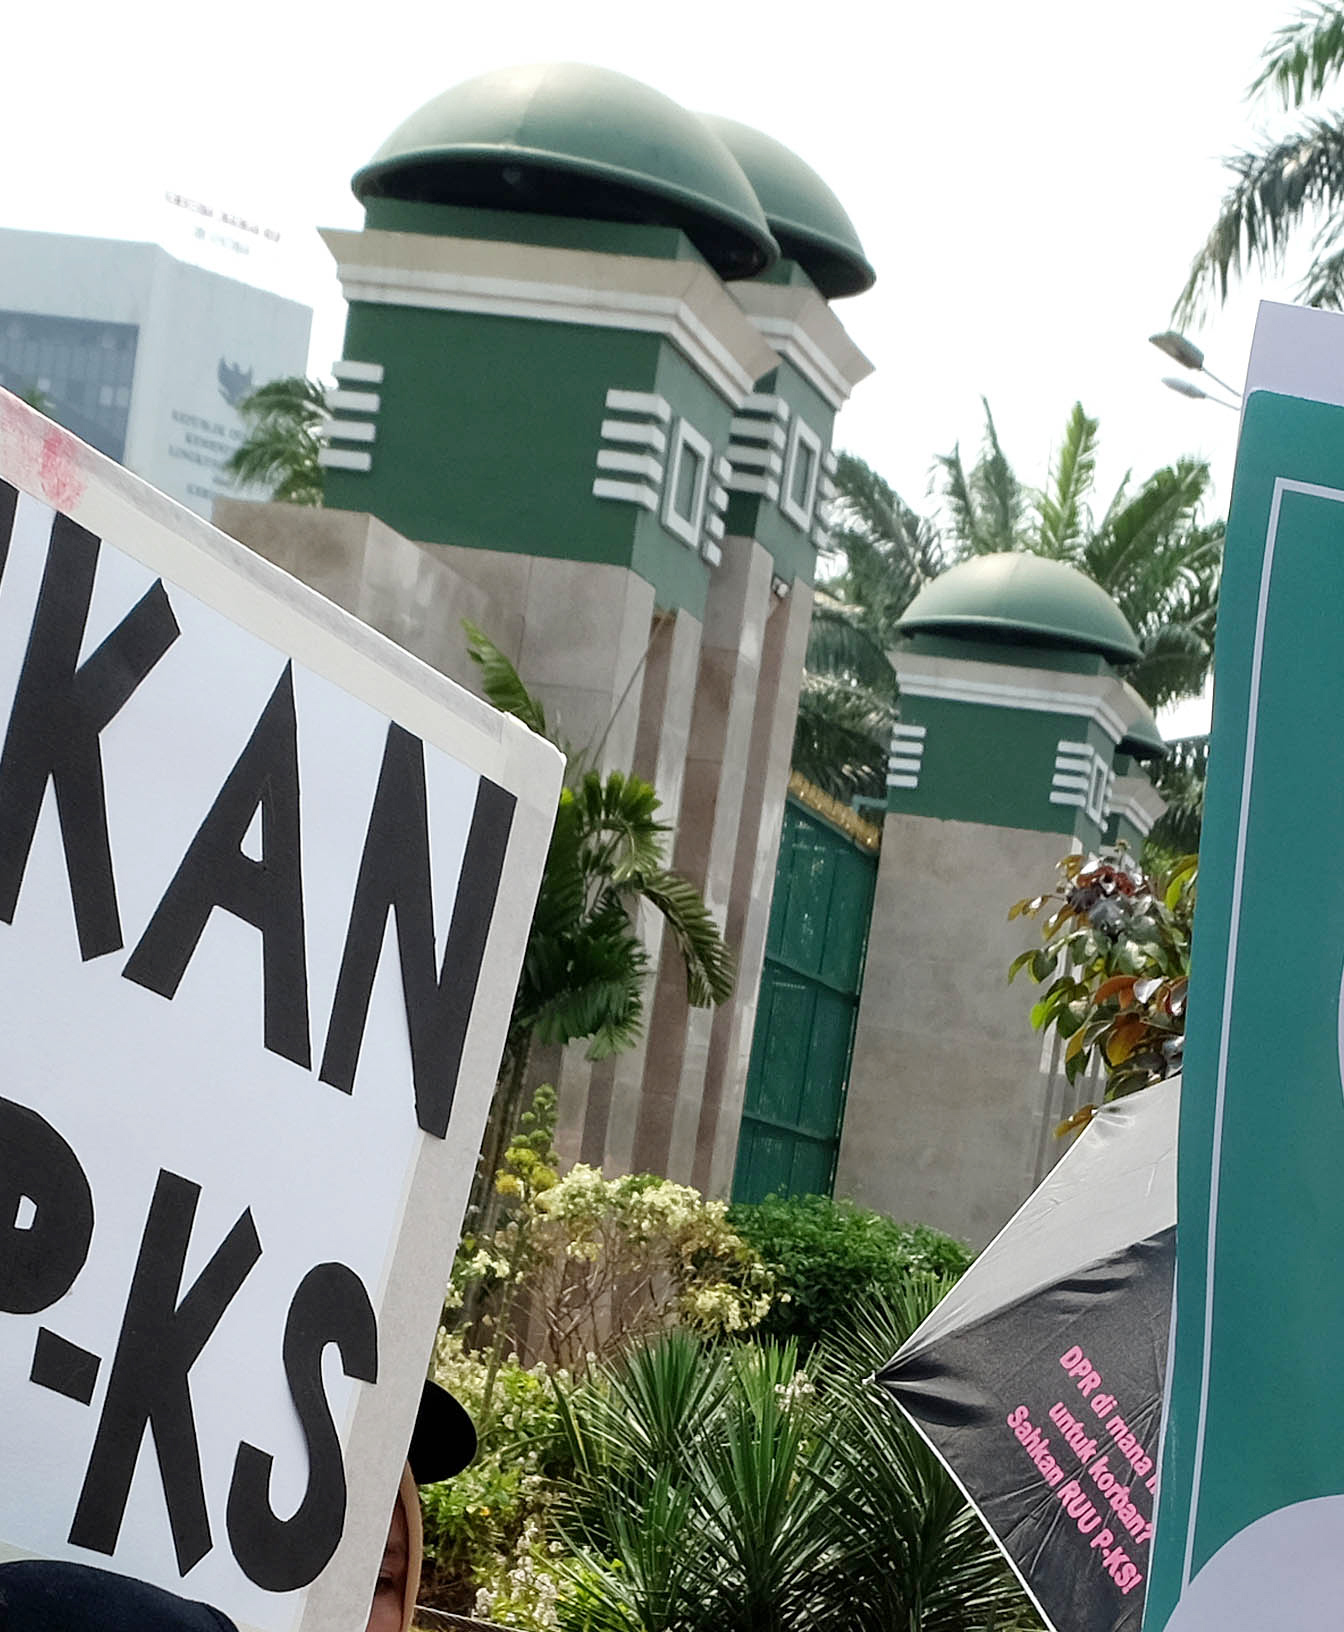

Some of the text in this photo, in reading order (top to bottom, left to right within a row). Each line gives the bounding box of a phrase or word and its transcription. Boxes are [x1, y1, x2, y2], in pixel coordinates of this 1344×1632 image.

[1007, 1405, 1065, 1487] Sahkan
[1056, 1479, 1103, 1534] RUU
[1048, 1401, 1098, 1464] untuk
[1059, 1345, 1153, 1477] DPR di mana
